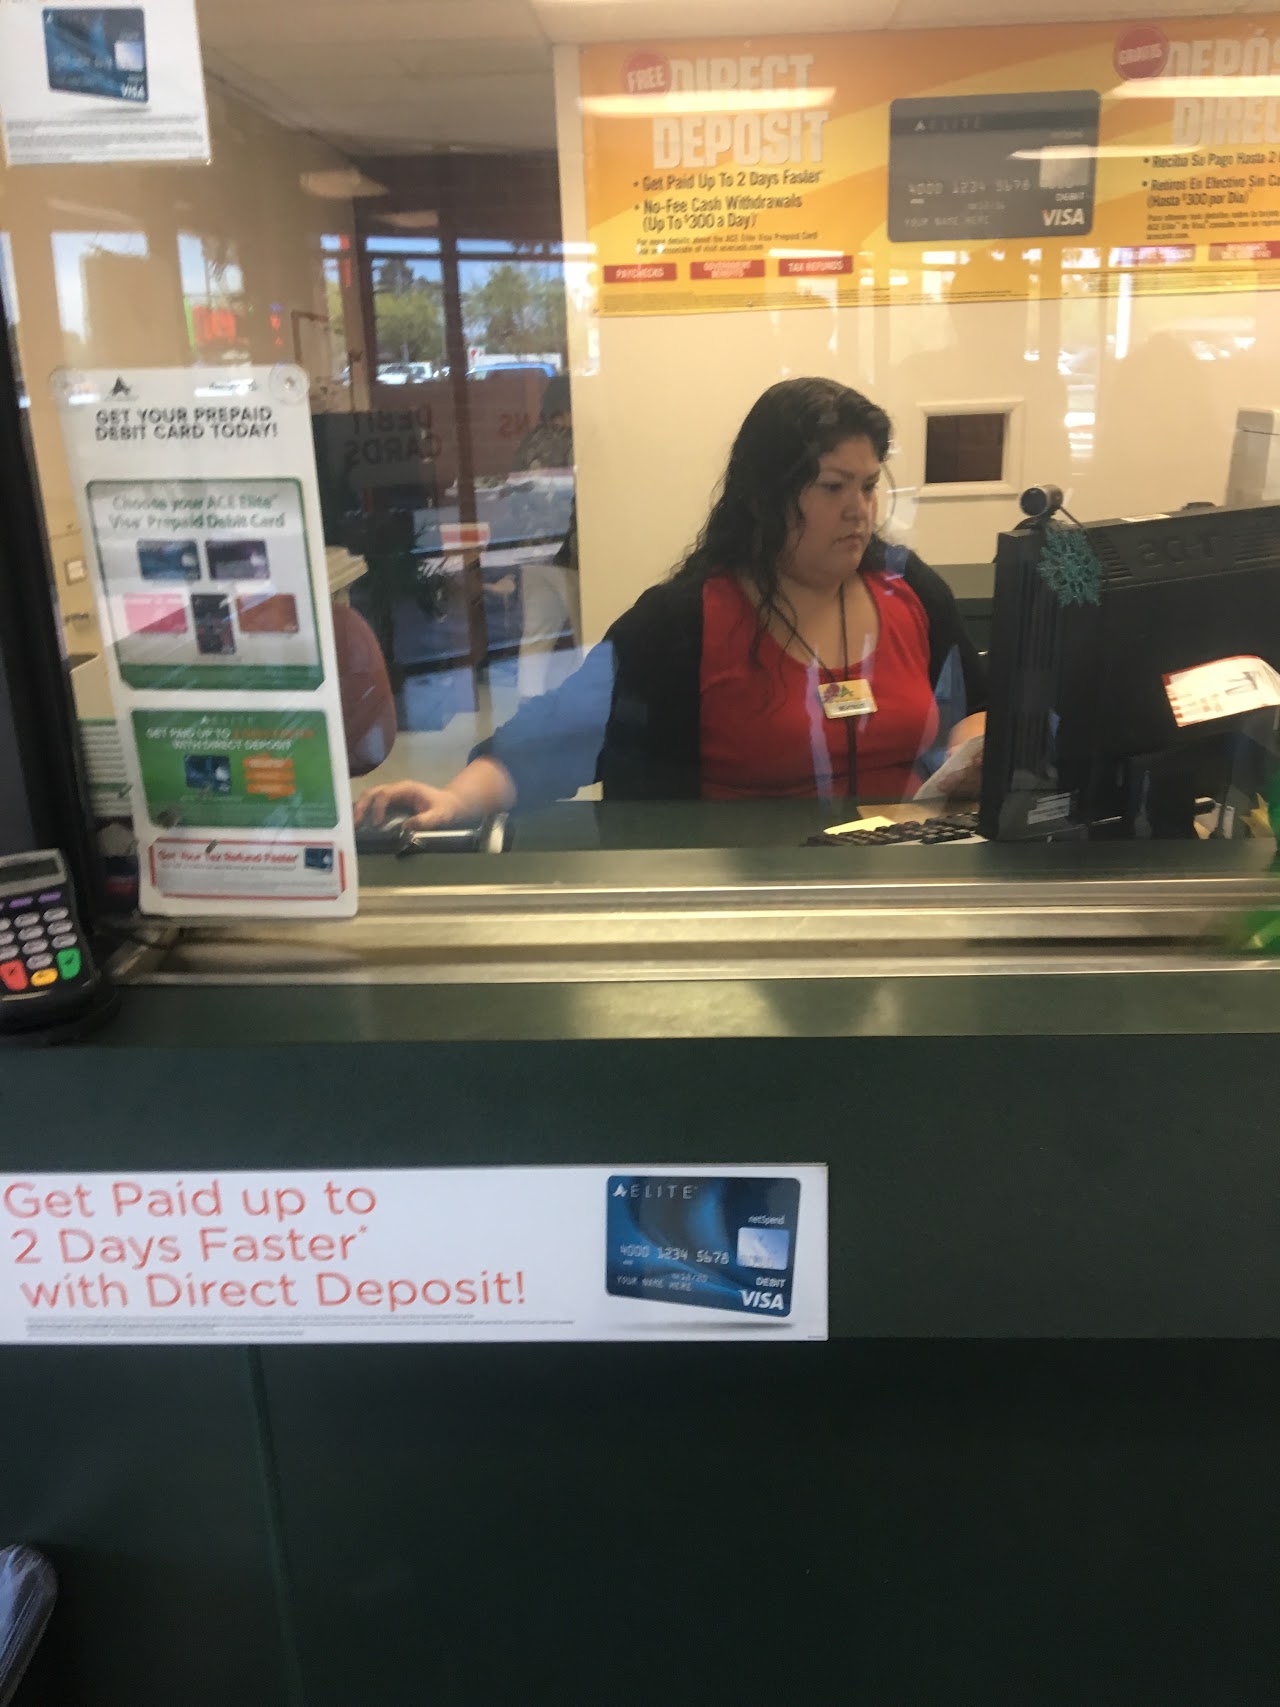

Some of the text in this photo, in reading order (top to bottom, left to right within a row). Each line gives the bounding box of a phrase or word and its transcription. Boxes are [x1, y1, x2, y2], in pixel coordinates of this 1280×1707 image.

[627, 65, 666, 93] FREE
[121, 83, 145, 99] VISA
[653, 111, 830, 169] DEPOSIT
[1208, 153, 1233, 168] Pago
[643, 175, 664, 191] Get
[667, 174, 694, 190] Paid
[698, 173, 714, 191] Up
[719, 172, 734, 187] To
[737, 171, 746, 187] 2
[750, 171, 779, 188] Days
[643, 193, 803, 214] No-Fee Cash Withdrawals
[642, 216, 665, 233] (Up
[667, 214, 682, 230] To
[717, 216, 724, 228] a
[1041, 208, 1085, 226] VISA
[96, 407, 272, 426] GET YOUR PREPAID
[95, 423, 278, 441] DEBIT CARD TODAY!
[3, 1180, 377, 1222] Get Paid up to
[10, 1230, 42, 1263] 2
[59, 1228, 182, 1269] Days
[657, 1247, 688, 1261] 1234
[696, 1249, 730, 1265] 5678
[19, 1270, 526, 1312] with Direct Deposit!
[755, 1276, 786, 1288] DEBIT
[738, 1289, 784, 1310] VISA
